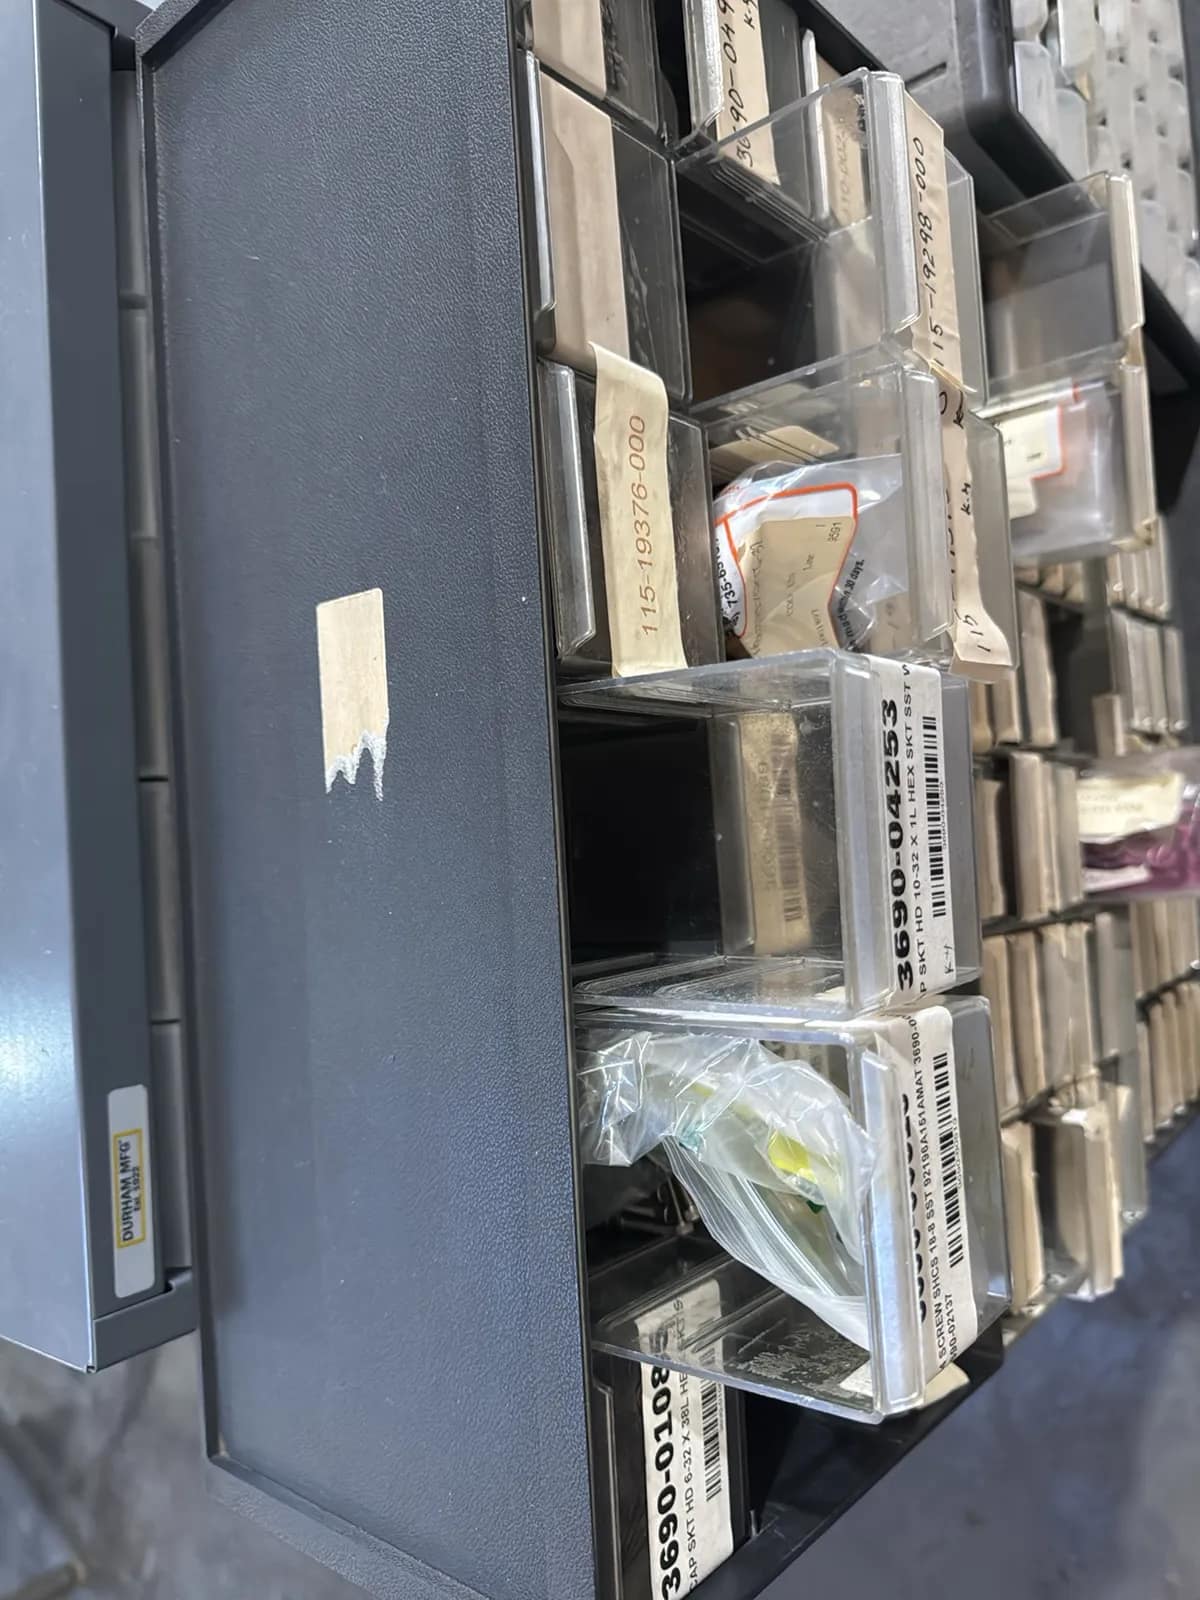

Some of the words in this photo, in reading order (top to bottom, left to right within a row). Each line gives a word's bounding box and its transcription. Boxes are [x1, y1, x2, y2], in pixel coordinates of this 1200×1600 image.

[628, 415, 659, 636] 115-19376-000
[903, 681, 912, 717] SST
[904, 723, 914, 759] SKT
[906, 765, 916, 802] HEX
[909, 807, 917, 828] 1L
[881, 699, 914, 991] 3690-04253
[910, 834, 918, 846] X
[911, 852, 921, 899] 10-32
[914, 906, 923, 932] HD
[917, 938, 926, 975] SKT
[912, 1069, 932, 1187] 92196A151AMAT
[119, 1176, 134, 1241] DURHAM
[924, 1191, 935, 1219] SST
[926, 1223, 938, 1253] 18-8
[929, 1255, 942, 1299] SHCS
[933, 1302, 947, 1359] SCREW
[681, 1397, 690, 1428] 38L
[681, 1431, 690, 1444] X
[682, 1447, 693, 1483] 6-32
[684, 1487, 694, 1514] HD
[686, 1517, 696, 1552] SKT
